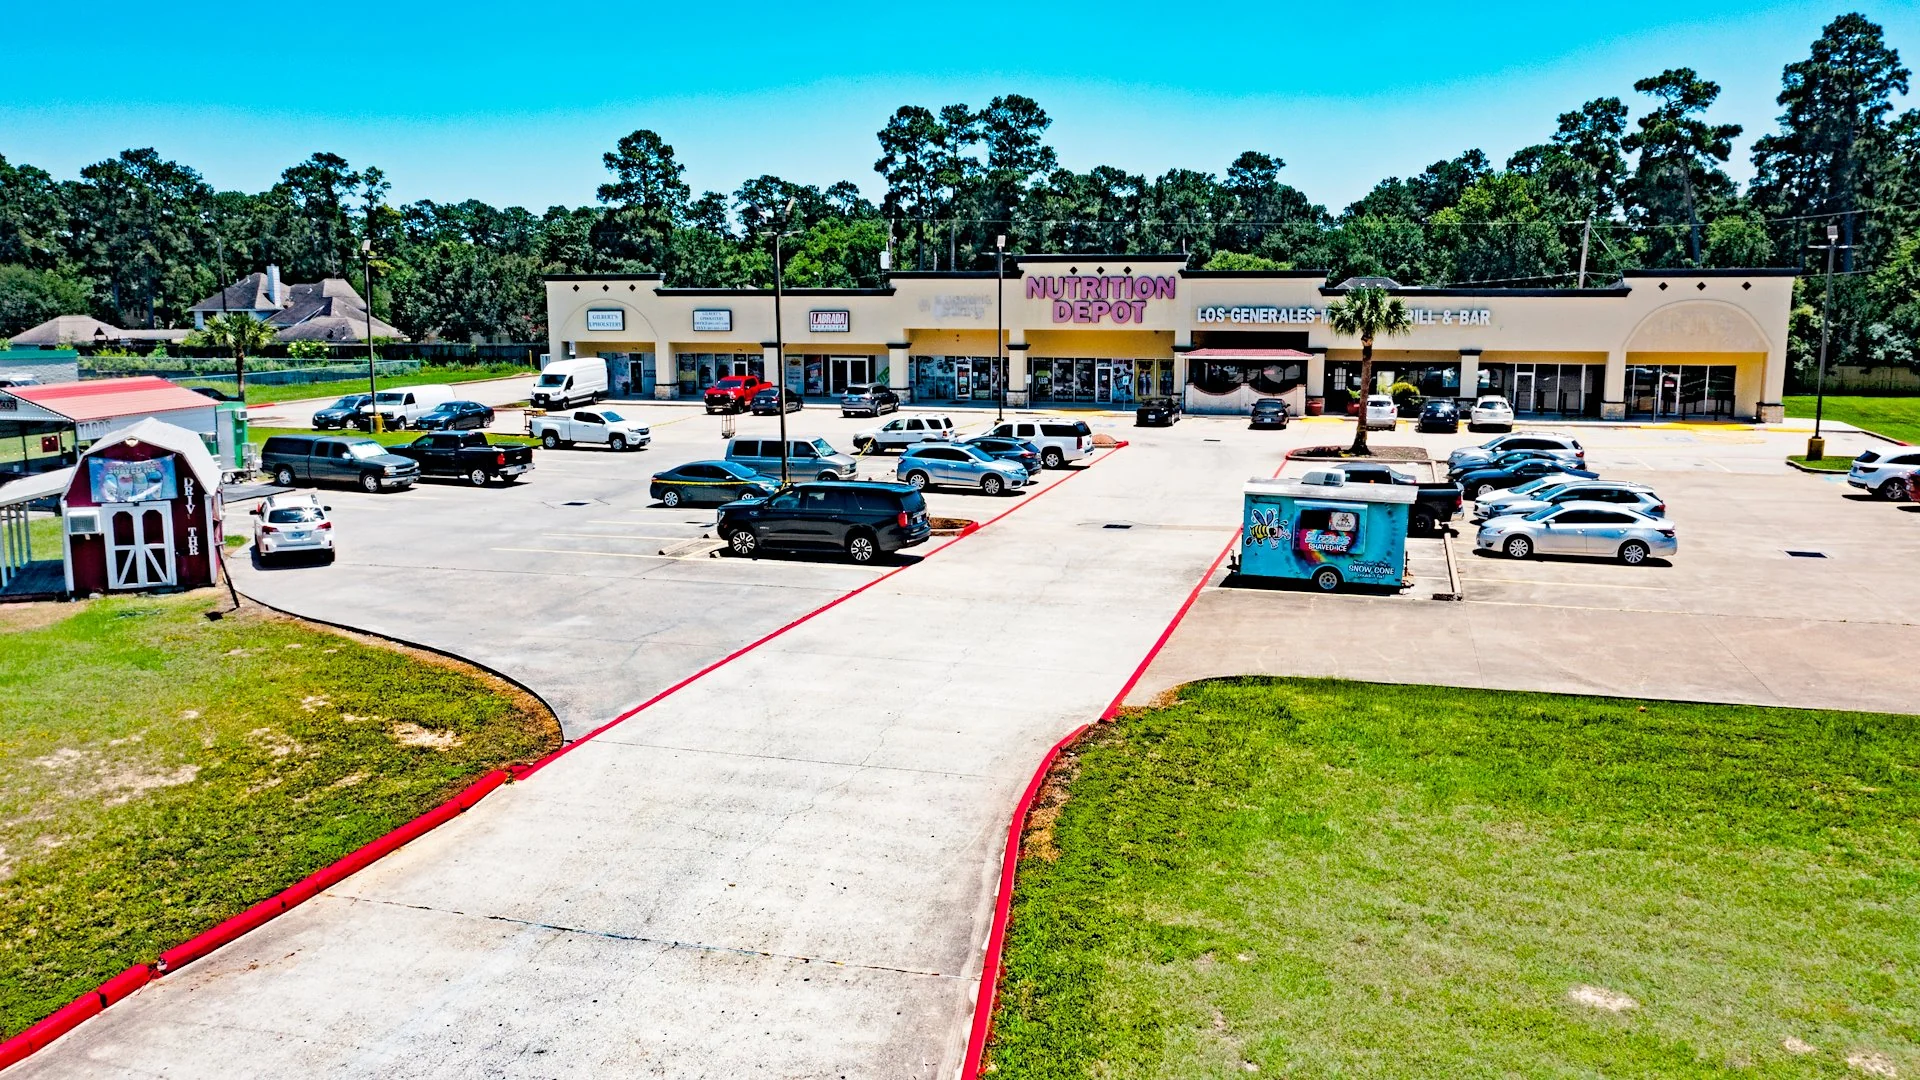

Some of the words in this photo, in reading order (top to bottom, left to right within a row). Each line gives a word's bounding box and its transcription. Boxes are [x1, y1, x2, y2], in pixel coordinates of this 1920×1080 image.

[1026, 276, 1176, 300] NUTRITION
[812, 313, 846, 324] LABRADA
[1052, 300, 1147, 324] DEPOT
[1197, 307, 1226, 323] LOS
[1230, 307, 1316, 324] GENERALES
[1404, 308, 1437, 325] RILL
[1442, 309, 1453, 325] &
[1459, 309, 1491, 326] BAR
[79, 420, 112, 437] TACOS
[1308, 543, 1335, 551] SHAVED
[1348, 564, 1372, 573] SNOW
[1374, 566, 1395, 575] CONE
